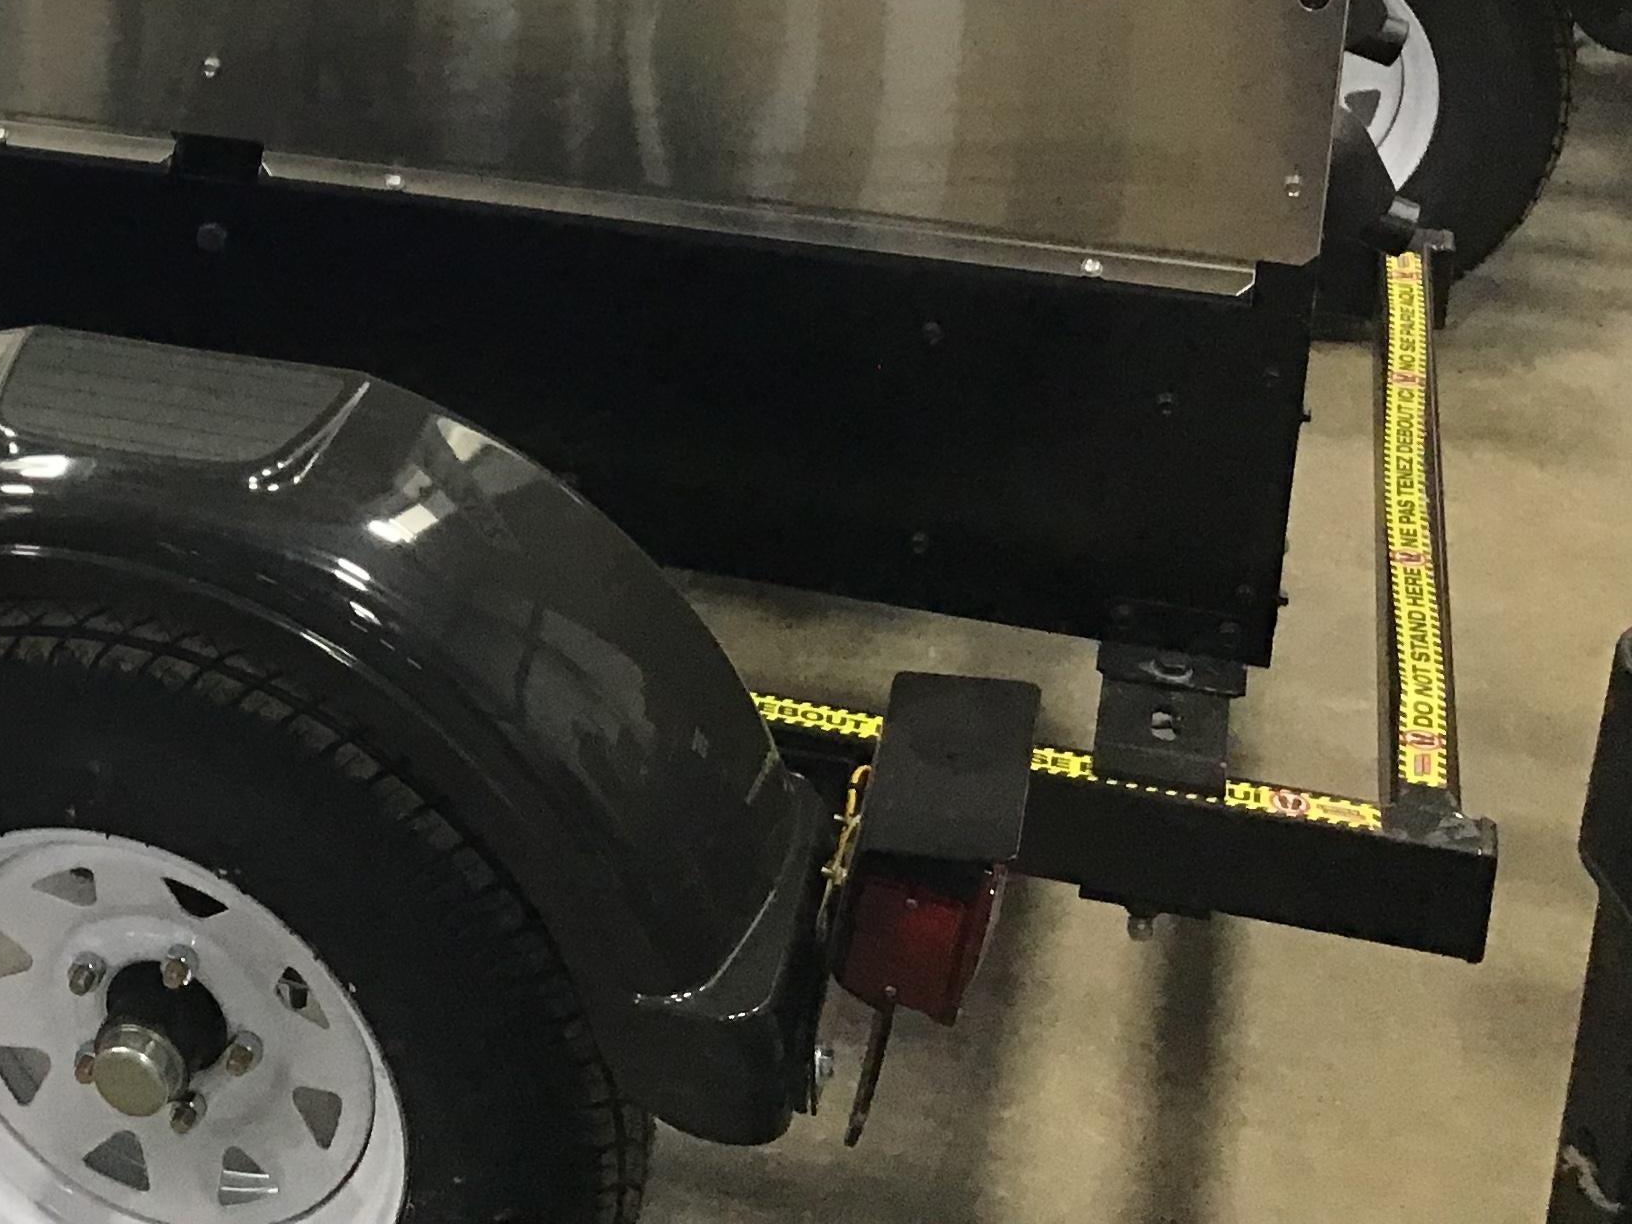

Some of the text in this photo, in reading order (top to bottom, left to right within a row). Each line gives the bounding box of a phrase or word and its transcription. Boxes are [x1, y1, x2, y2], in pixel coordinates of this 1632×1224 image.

[1399, 306, 1416, 336] PARE
[1399, 337, 1416, 353] SE
[1398, 354, 1415, 371] NO
[1396, 404, 1415, 454] DEBOUT
[1396, 455, 1415, 496] TENEZ
[1397, 499, 1416, 525] PAS
[1400, 528, 1418, 548] NE
[1404, 567, 1434, 729] DO NOT STAND HERE
